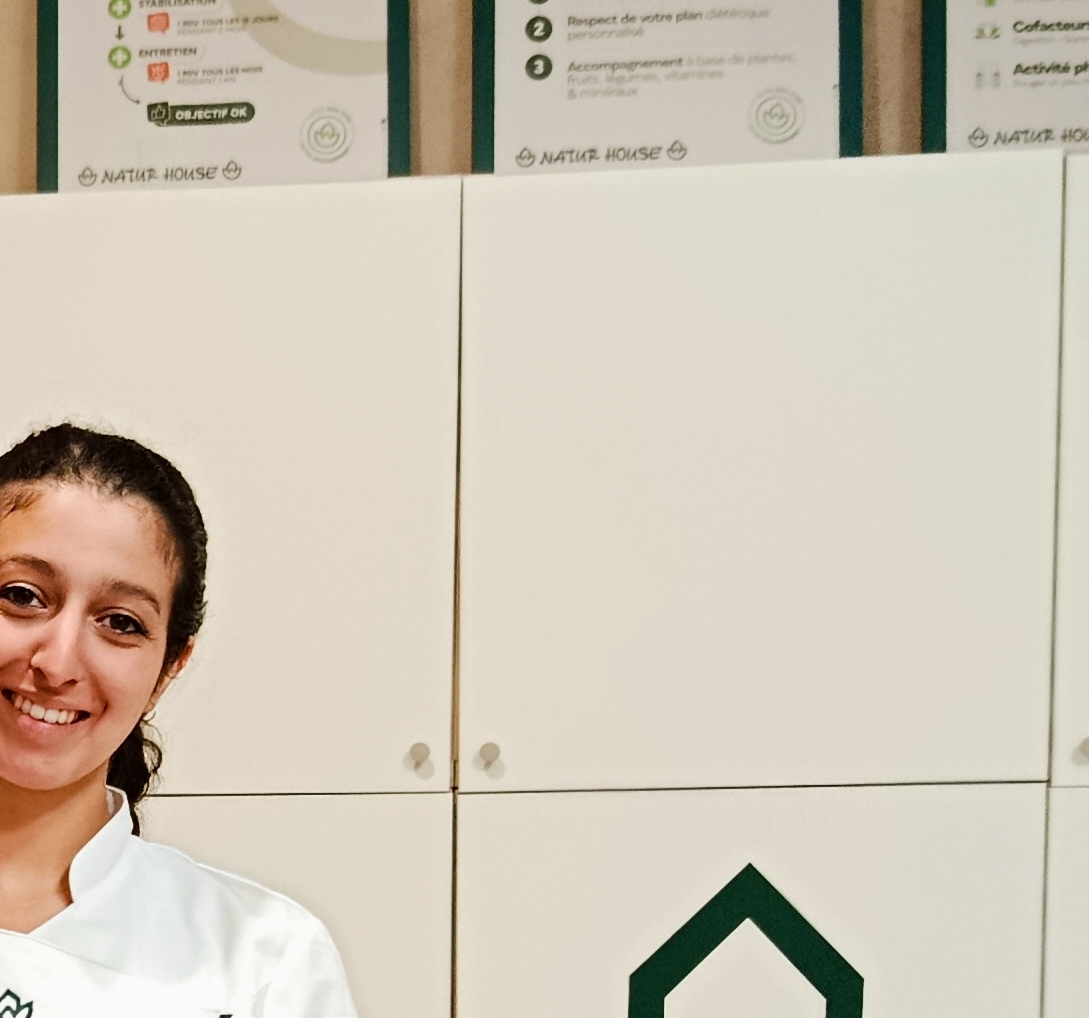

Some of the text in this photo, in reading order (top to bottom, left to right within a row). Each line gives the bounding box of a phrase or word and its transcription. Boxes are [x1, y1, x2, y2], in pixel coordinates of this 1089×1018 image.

[568, 15, 617, 27] Respect
[620, 13, 636, 23] de
[641, 12, 673, 24] votre
[676, 11, 703, 23] plan
[533, 22, 545, 37] 2
[1013, 20, 1089, 34] Cofacteur
[138, 48, 197, 58] ENTRETIEN
[533, 60, 544, 75] 3
[567, 57, 684, 74] Accompagnement
[1013, 61, 1071, 75] Activité
[175, 107, 247, 121] OBJECTIF OK
[993, 127, 1089, 145] NATUR HOU
[540, 147, 663, 165] NATUR HOUSE
[101, 167, 218, 184] NATUR HOUSE
